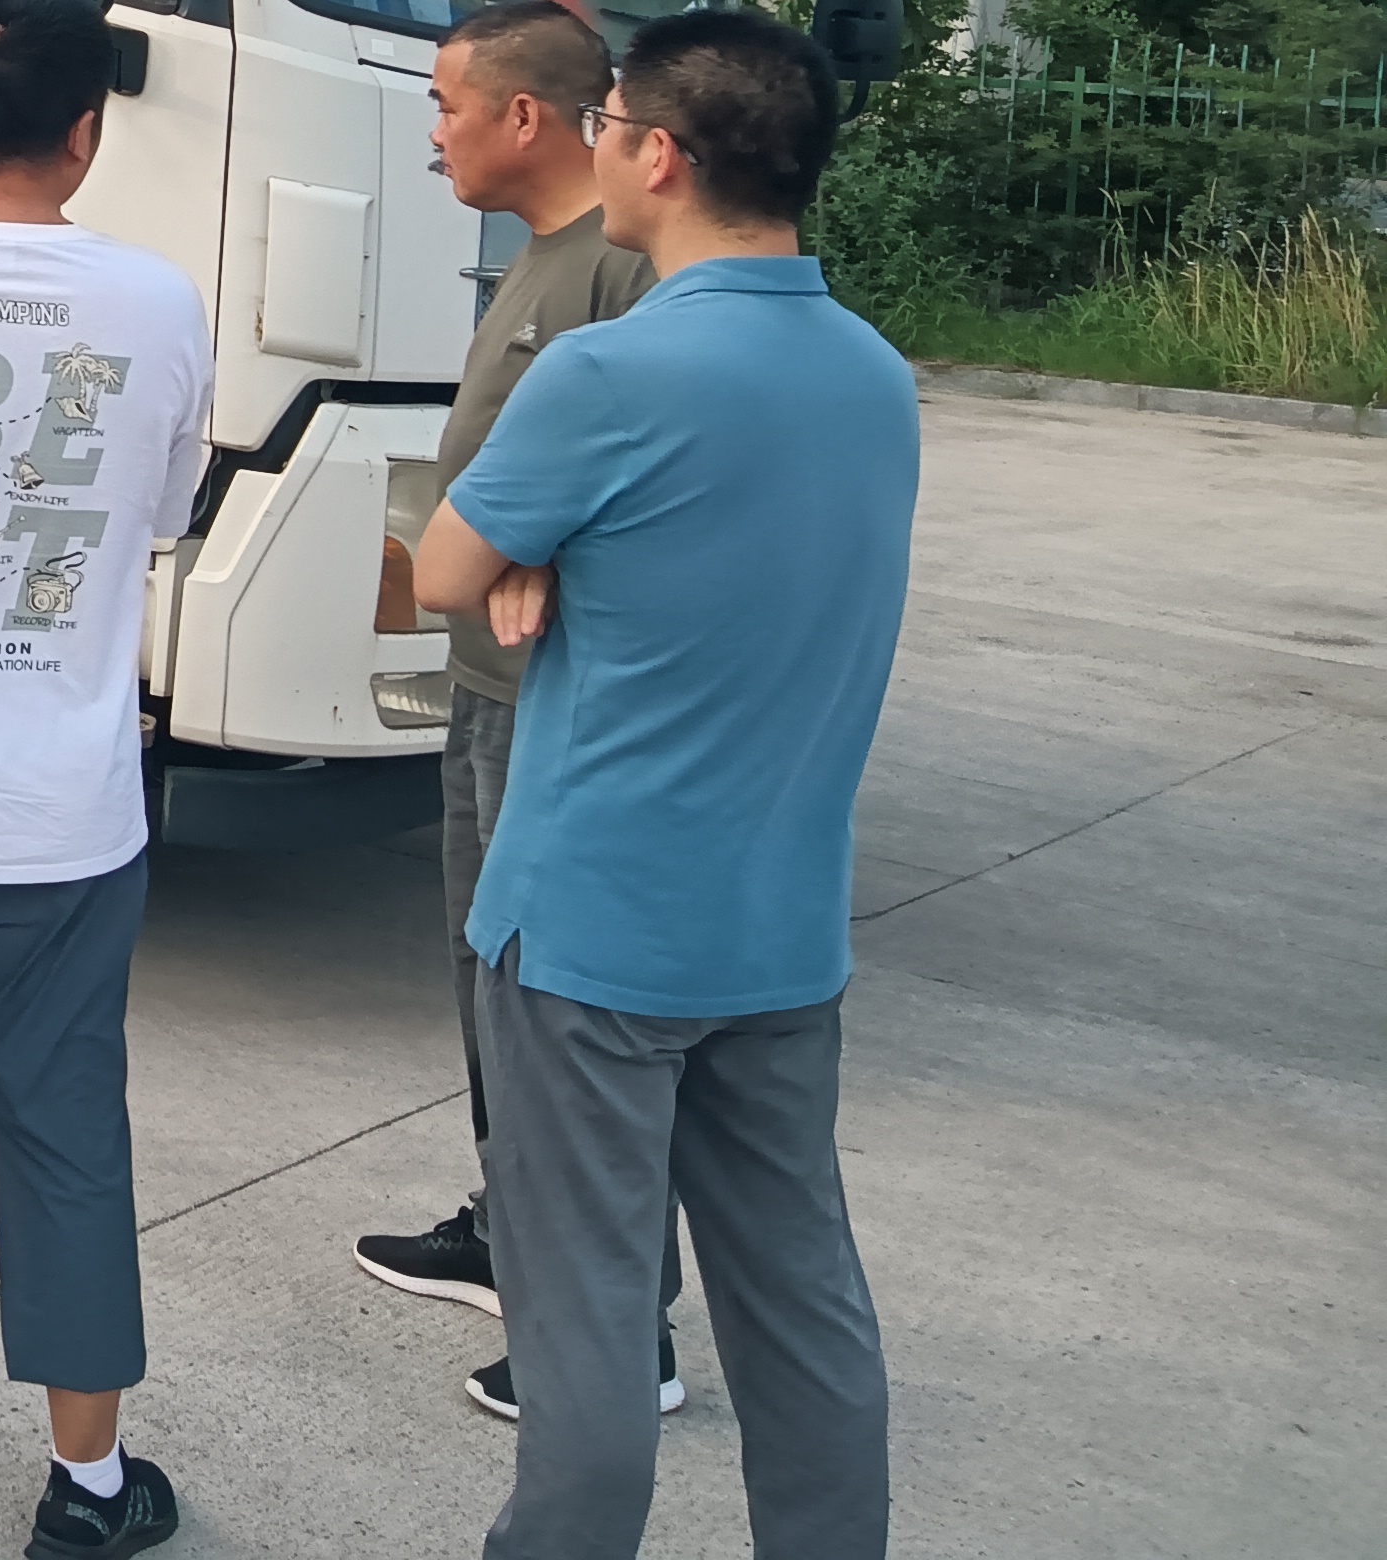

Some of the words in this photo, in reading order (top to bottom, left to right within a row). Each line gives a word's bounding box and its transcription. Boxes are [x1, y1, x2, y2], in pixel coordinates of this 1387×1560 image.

[52, 426, 104, 437] VACATION
[9, 491, 42, 503] ENJOY
[43, 496, 70, 506] LIFE
[12, 615, 52, 627] RECORD
[53, 620, 78, 629] LIFE
[35, 659, 62, 672] LIFE
